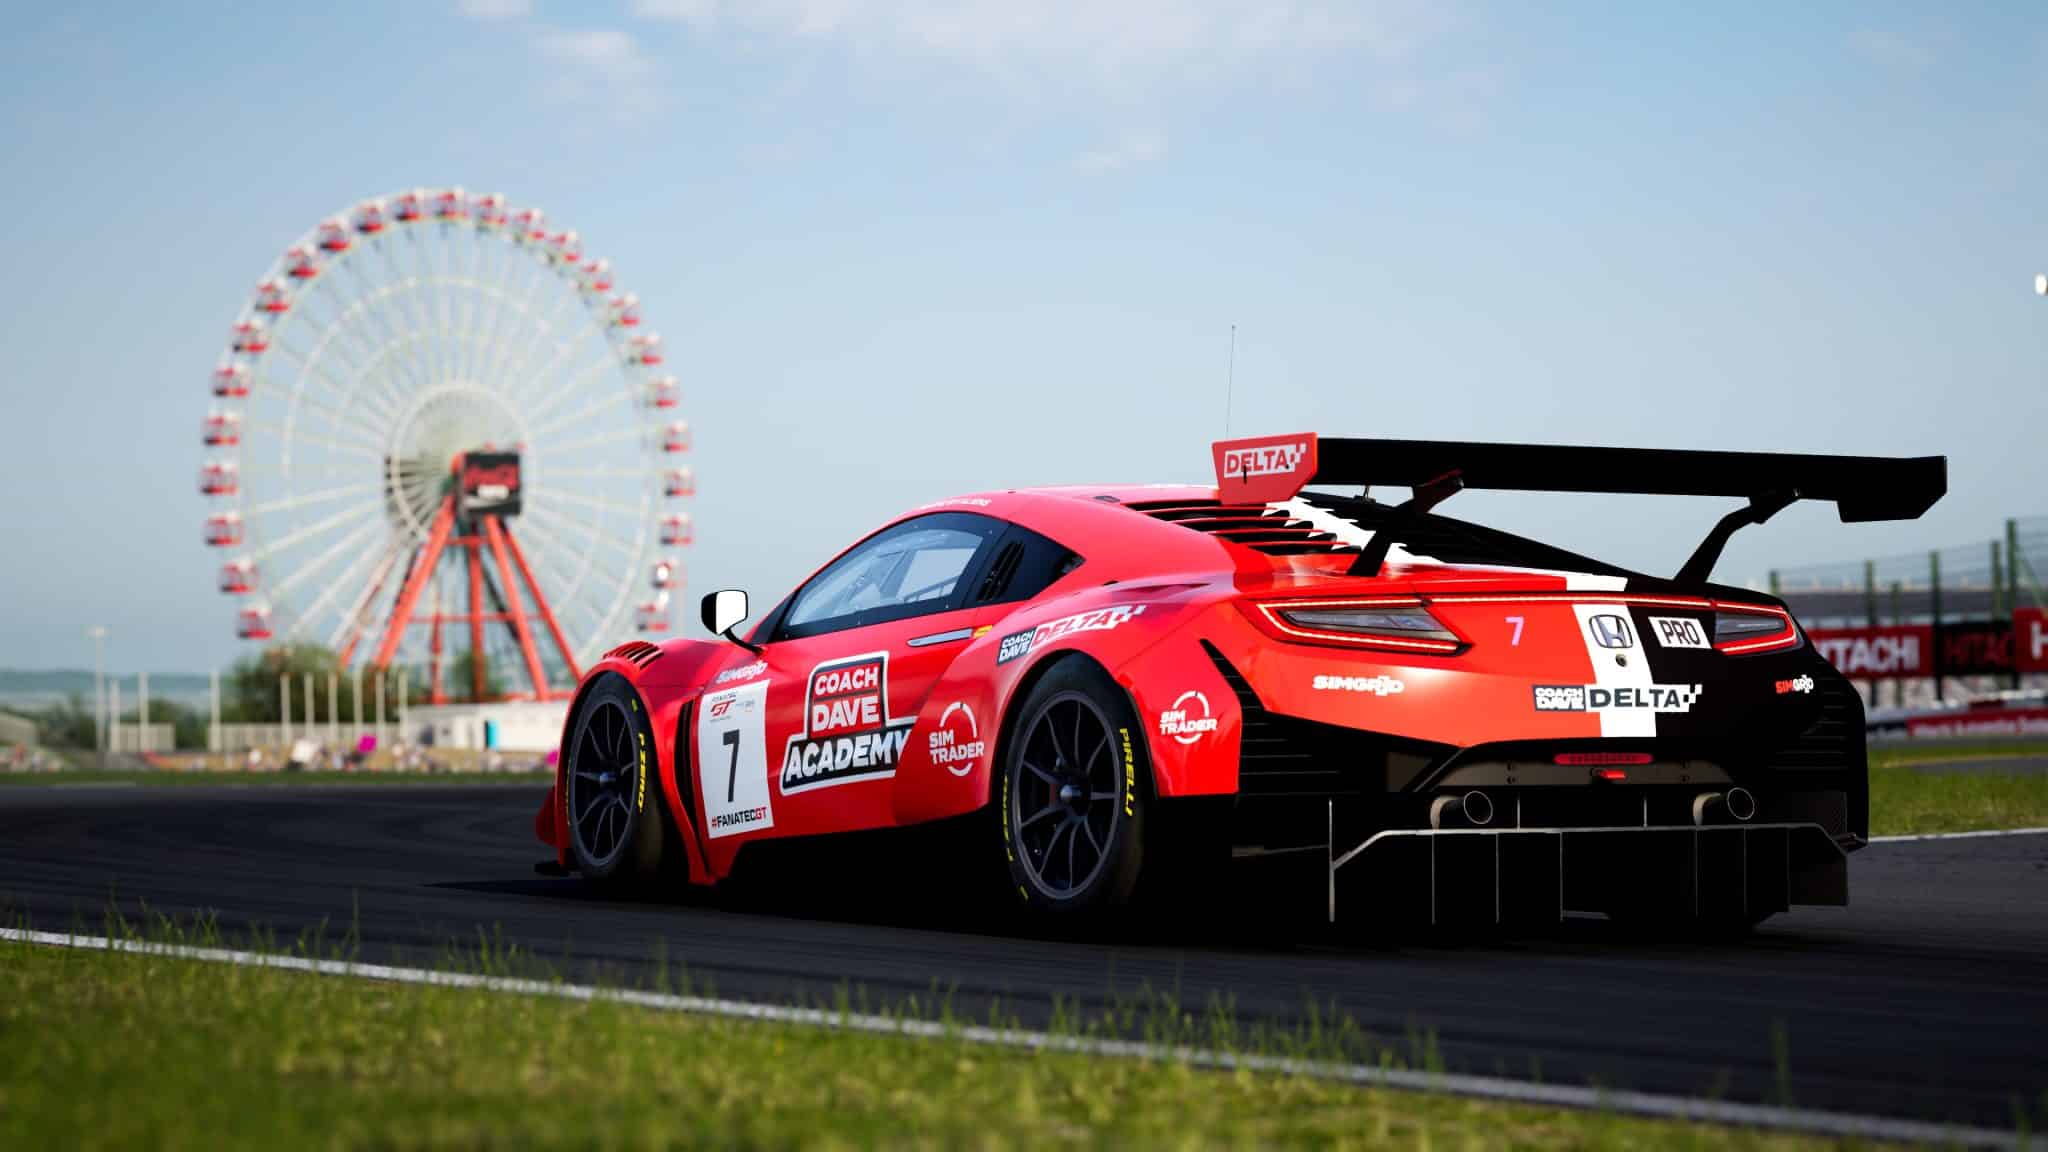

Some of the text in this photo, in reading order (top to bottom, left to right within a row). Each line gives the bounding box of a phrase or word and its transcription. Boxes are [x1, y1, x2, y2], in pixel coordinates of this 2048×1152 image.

[1226, 449, 1288, 474] DELTA
[1002, 630, 1034, 649] COACH
[1035, 610, 1112, 645] DELTA
[1505, 616, 1524, 646] 7
[1658, 619, 1701, 645] PRO
[998, 640, 1032, 662] DAVE
[1812, 636, 1919, 672] ITACHI
[815, 666, 878, 695] COACH
[1535, 687, 1584, 699] COACH
[1536, 697, 1584, 710] DAVE
[1590, 688, 1681, 708] DELTA
[812, 696, 880, 732] DAVE
[1160, 710, 1187, 723] SIM
[929, 728, 955, 748] SIM
[1160, 718, 1217, 735] TRADER
[786, 728, 912, 783] ACADEMY
[929, 741, 985, 765] TRADER
[723, 729, 740, 803] 7
[1119, 728, 1135, 817] PIRELLI
[711, 806, 767, 828] #FANATECGT
